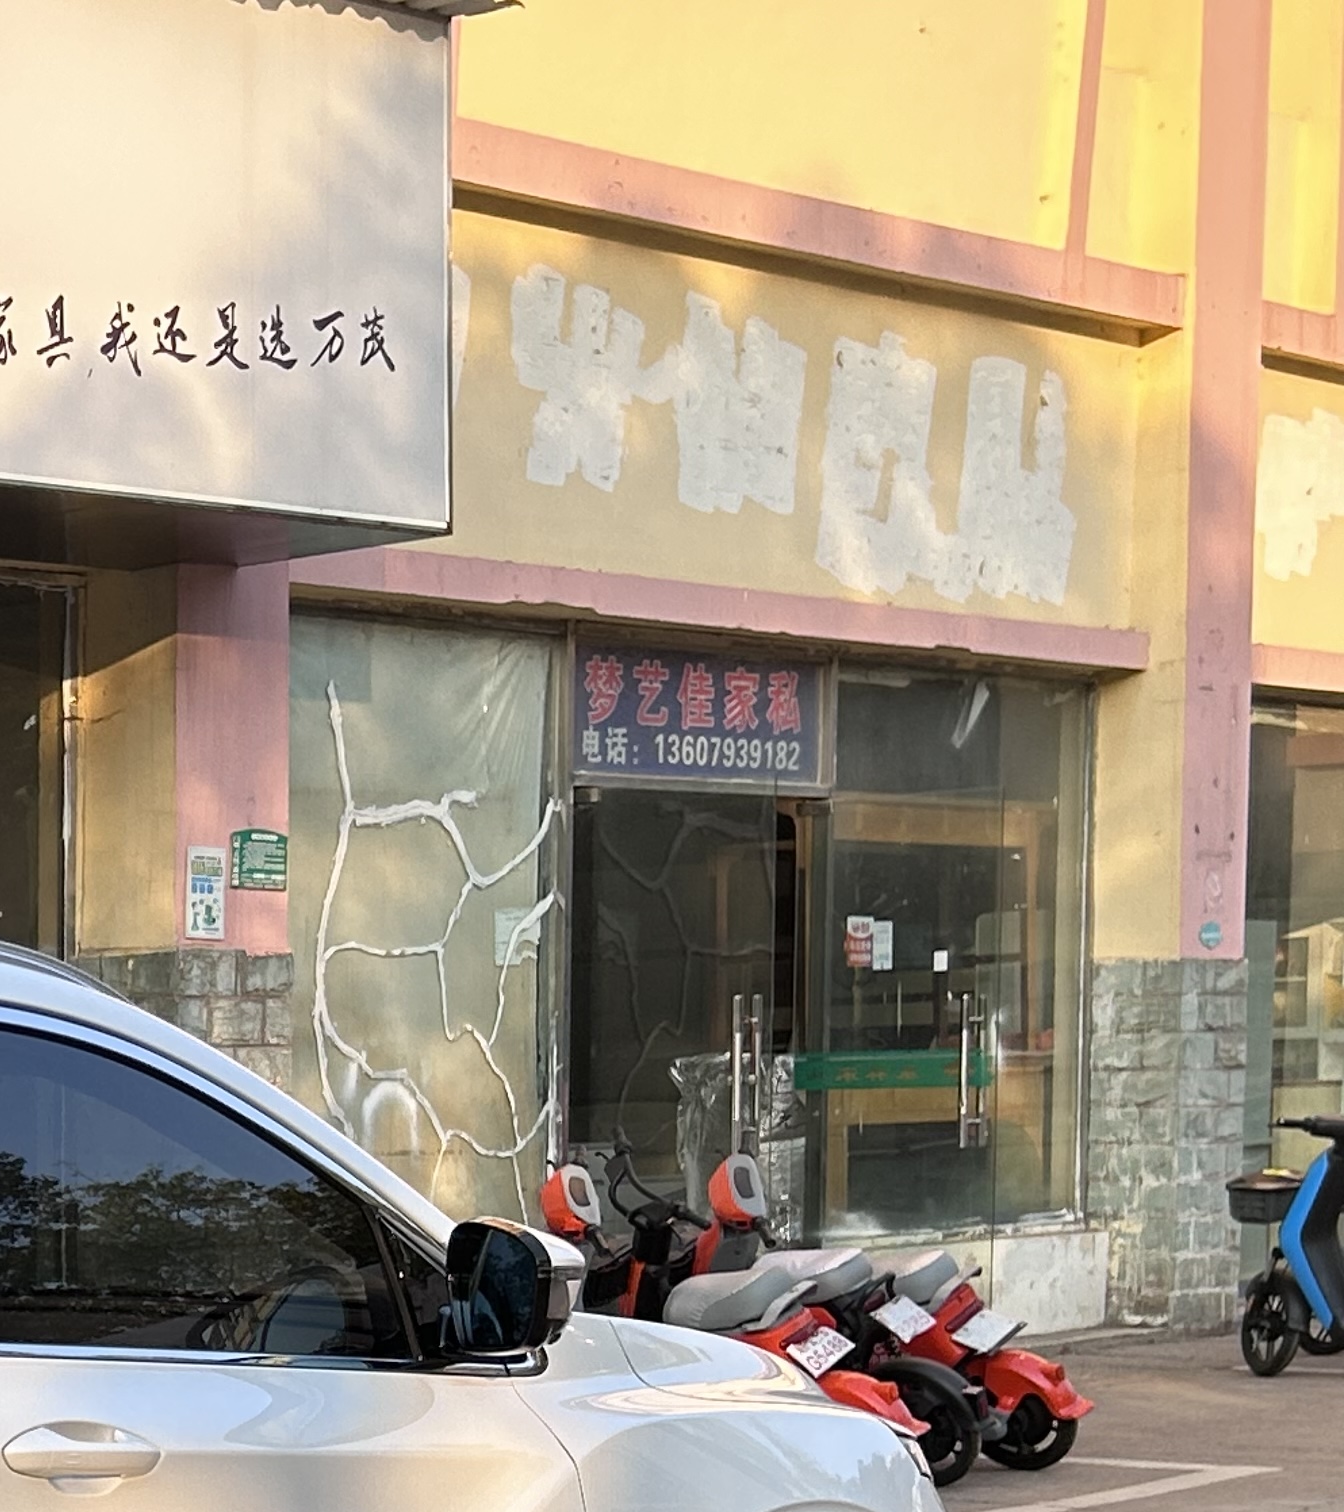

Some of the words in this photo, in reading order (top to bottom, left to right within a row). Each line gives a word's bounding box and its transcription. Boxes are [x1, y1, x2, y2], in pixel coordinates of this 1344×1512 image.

[584, 655, 802, 735] 梦艺佳家私
[654, 733, 801, 771] 13607939182
